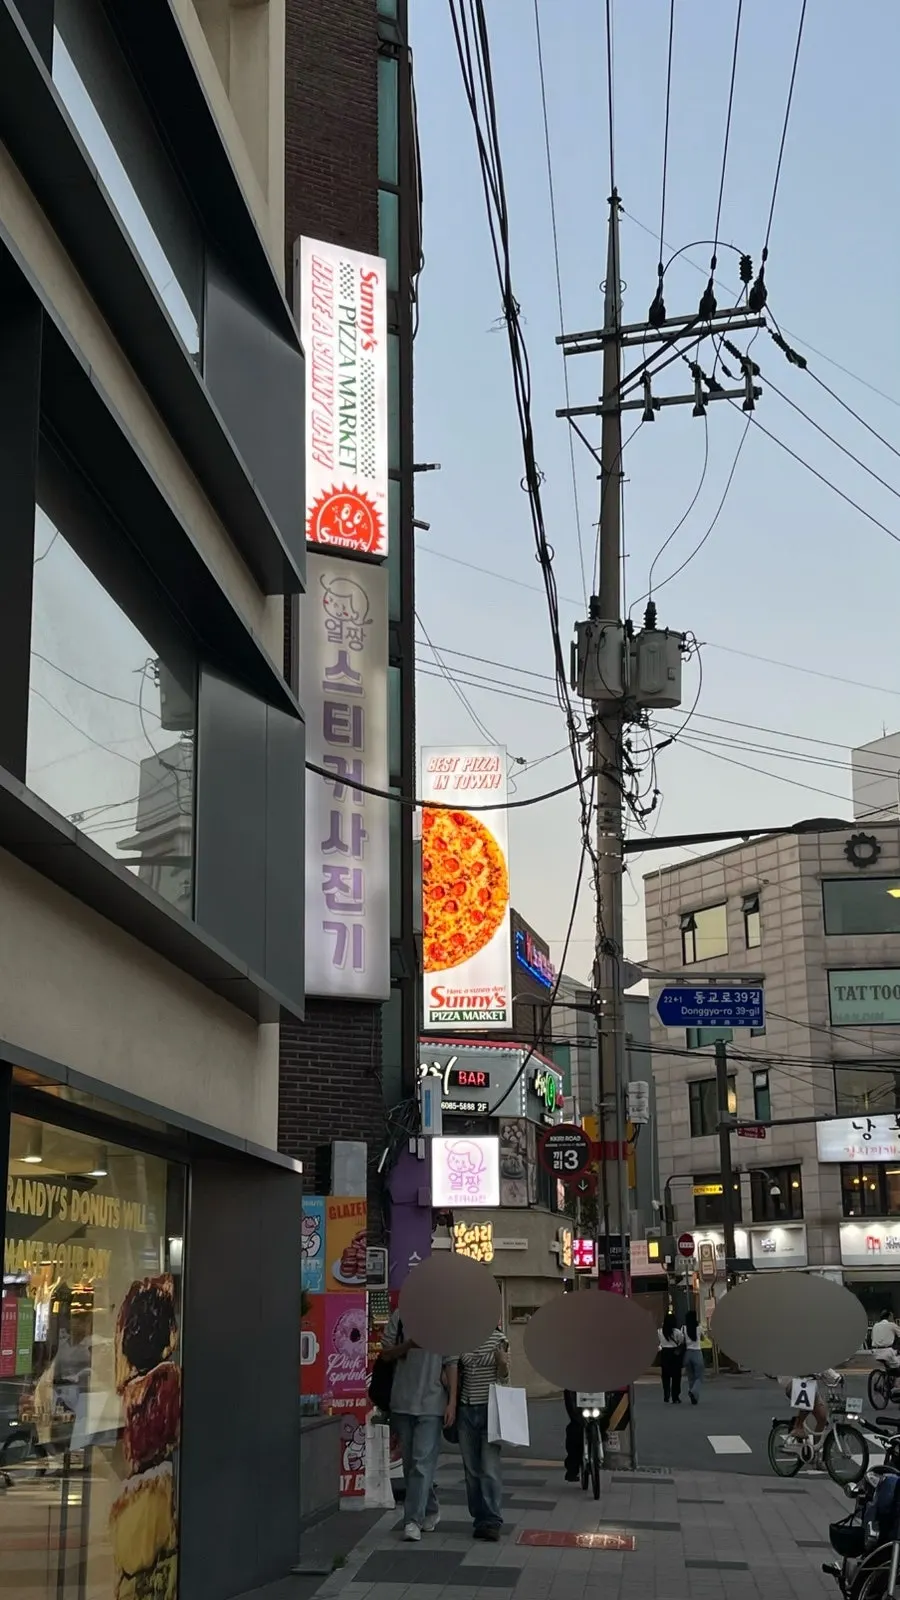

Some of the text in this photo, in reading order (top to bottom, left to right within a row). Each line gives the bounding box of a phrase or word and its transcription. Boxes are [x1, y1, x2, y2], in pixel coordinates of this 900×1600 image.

[356, 267, 379, 353] Sunny's
[311, 254, 333, 470] HAVE A SUNNY DAY!
[338, 304, 357, 474] PIZZA MARKET
[319, 527, 368, 551] Sunny's
[427, 756, 500, 773] BEST PIZZA
[433, 774, 502, 790] IN TOWN!
[429, 985, 507, 1010] Sunny's
[694, 991, 760, 1005] 동교로39길
[834, 984, 900, 1002] TATTOO
[431, 1011, 504, 1021] PIZZA MARKET
[681, 1006, 760, 1017] Donggyo-ro 39-gil
[458, 1071, 486, 1086] BAR
[564, 1149, 579, 1170] 3
[6, 1177, 147, 1233] RANDY'S DONUTS WILL
[4, 1238, 112, 1278] MAKE YOUR DAY
[326, 1353, 362, 1375] Pink
